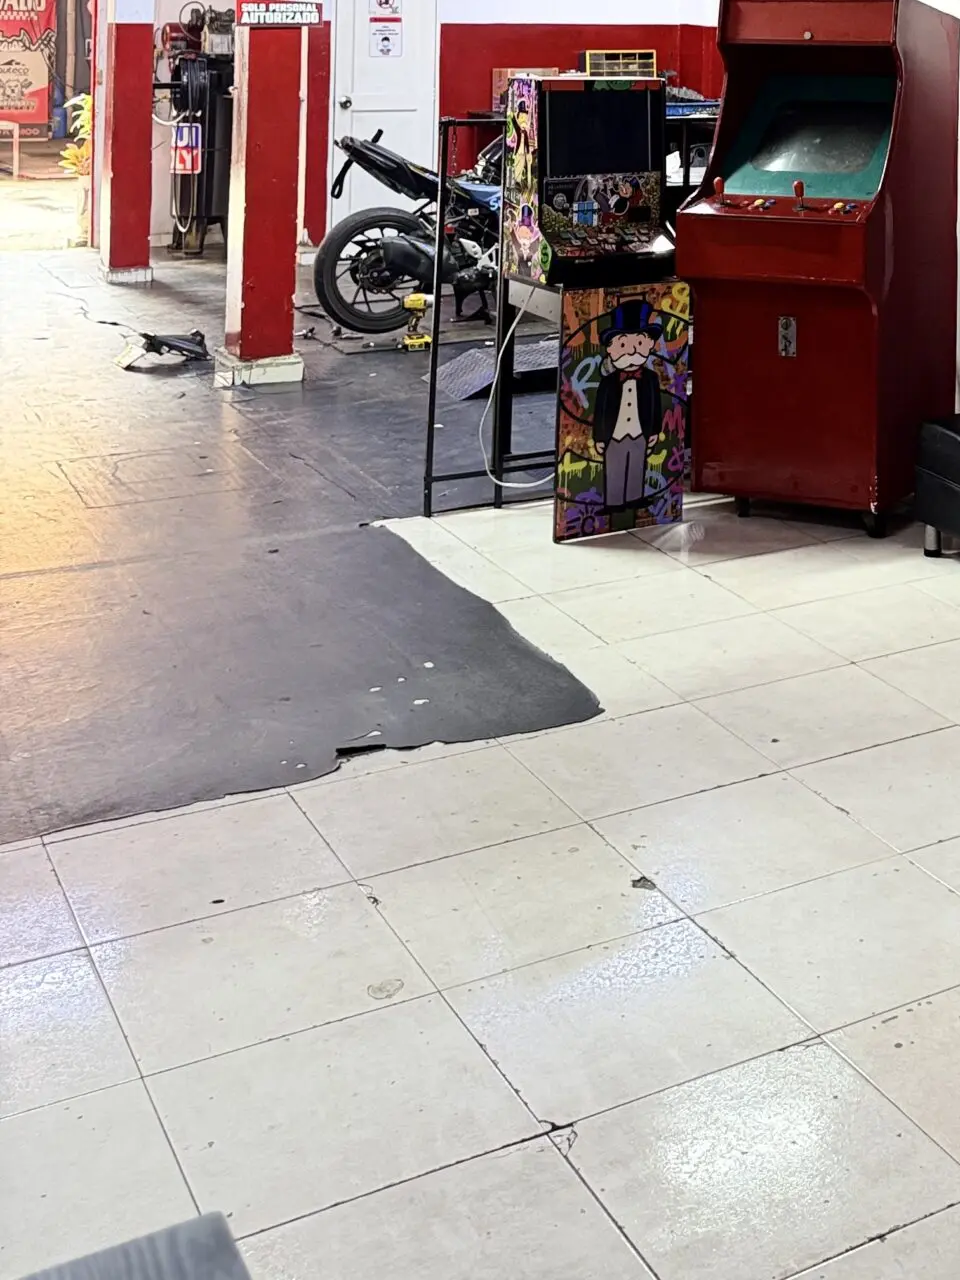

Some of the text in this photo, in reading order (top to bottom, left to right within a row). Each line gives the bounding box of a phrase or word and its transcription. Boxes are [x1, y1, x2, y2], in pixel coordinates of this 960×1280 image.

[241, 3, 318, 12] SOLO PERSONAL
[241, 12, 320, 24] AUTORIZADO
